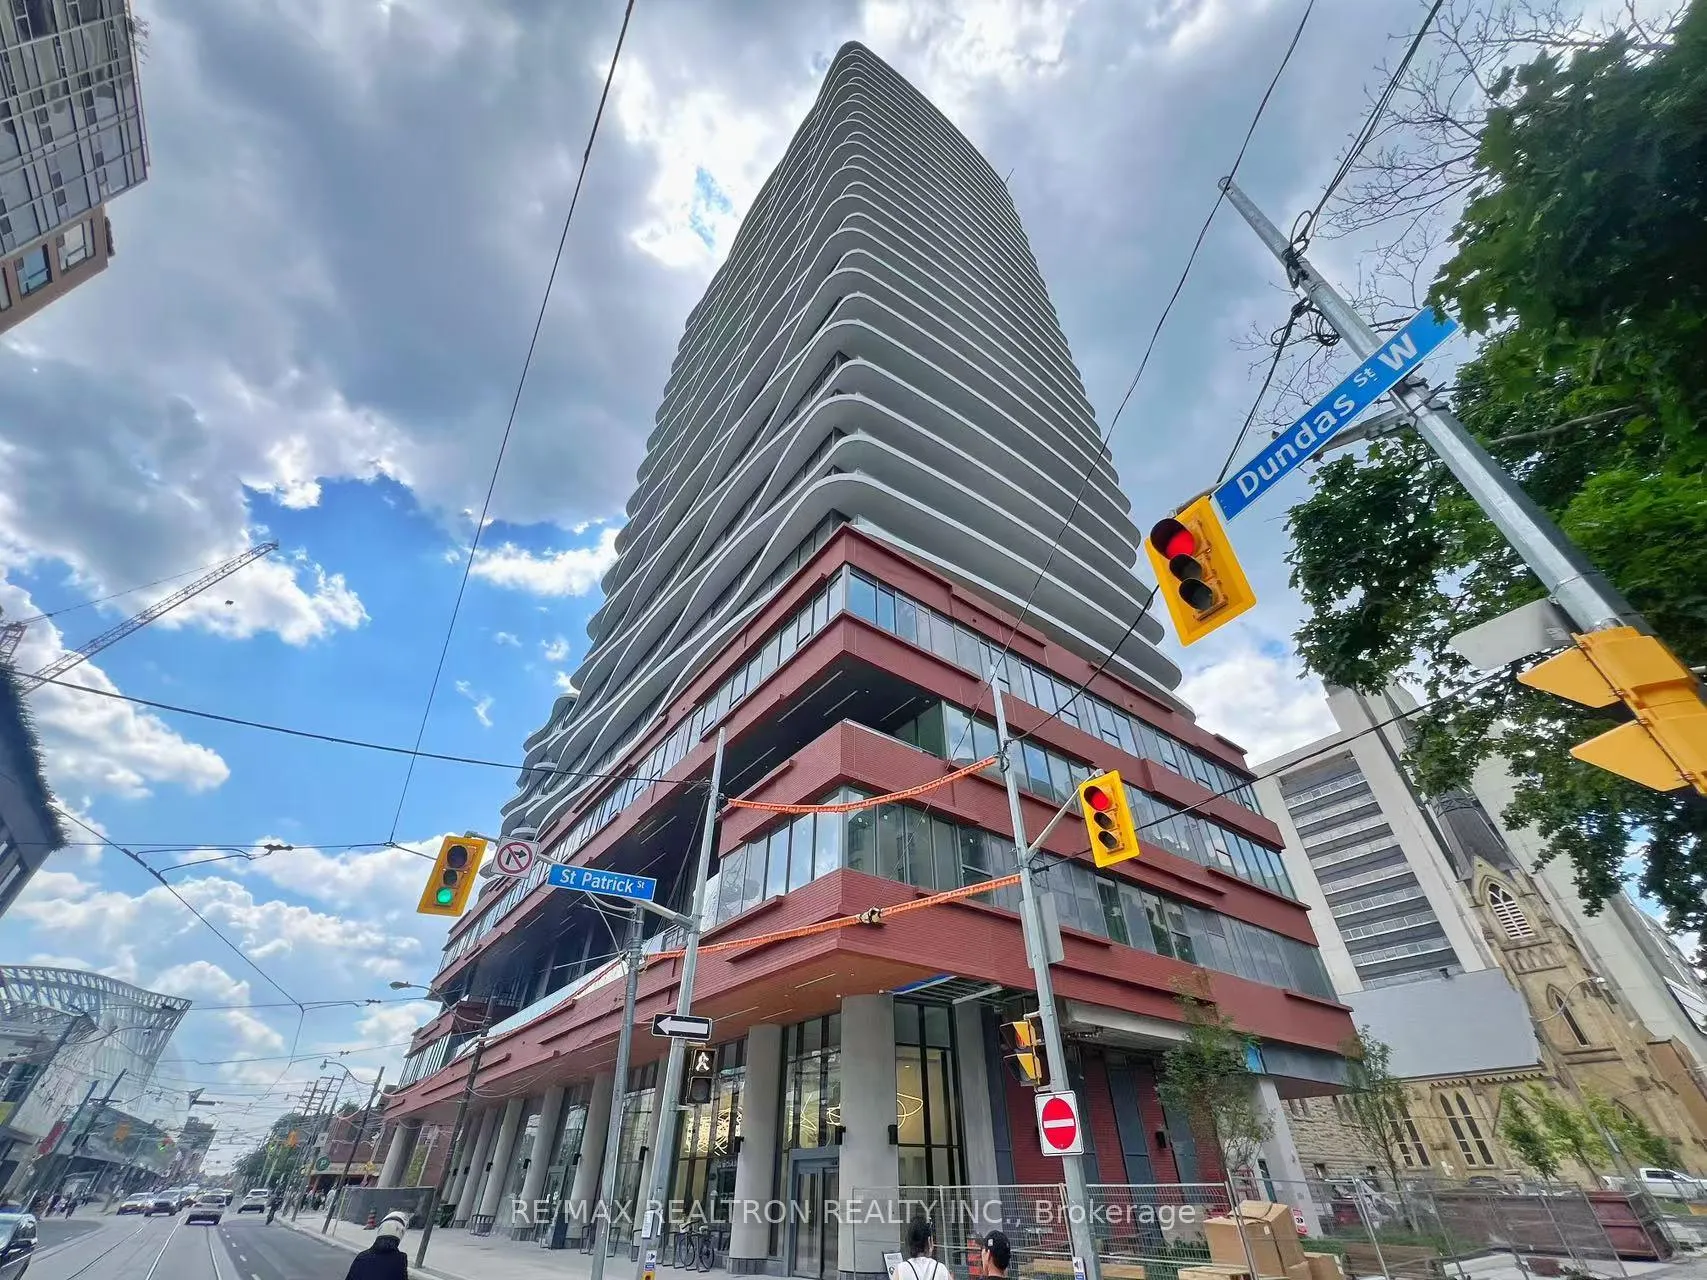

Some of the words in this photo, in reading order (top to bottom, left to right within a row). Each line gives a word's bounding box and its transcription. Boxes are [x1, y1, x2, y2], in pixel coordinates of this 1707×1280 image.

[1236, 394, 1355, 498] Dundas
[1378, 333, 1418, 371] W
[560, 869, 576, 884] St
[582, 872, 634, 893] Patrick
[637, 880, 645, 888] St
